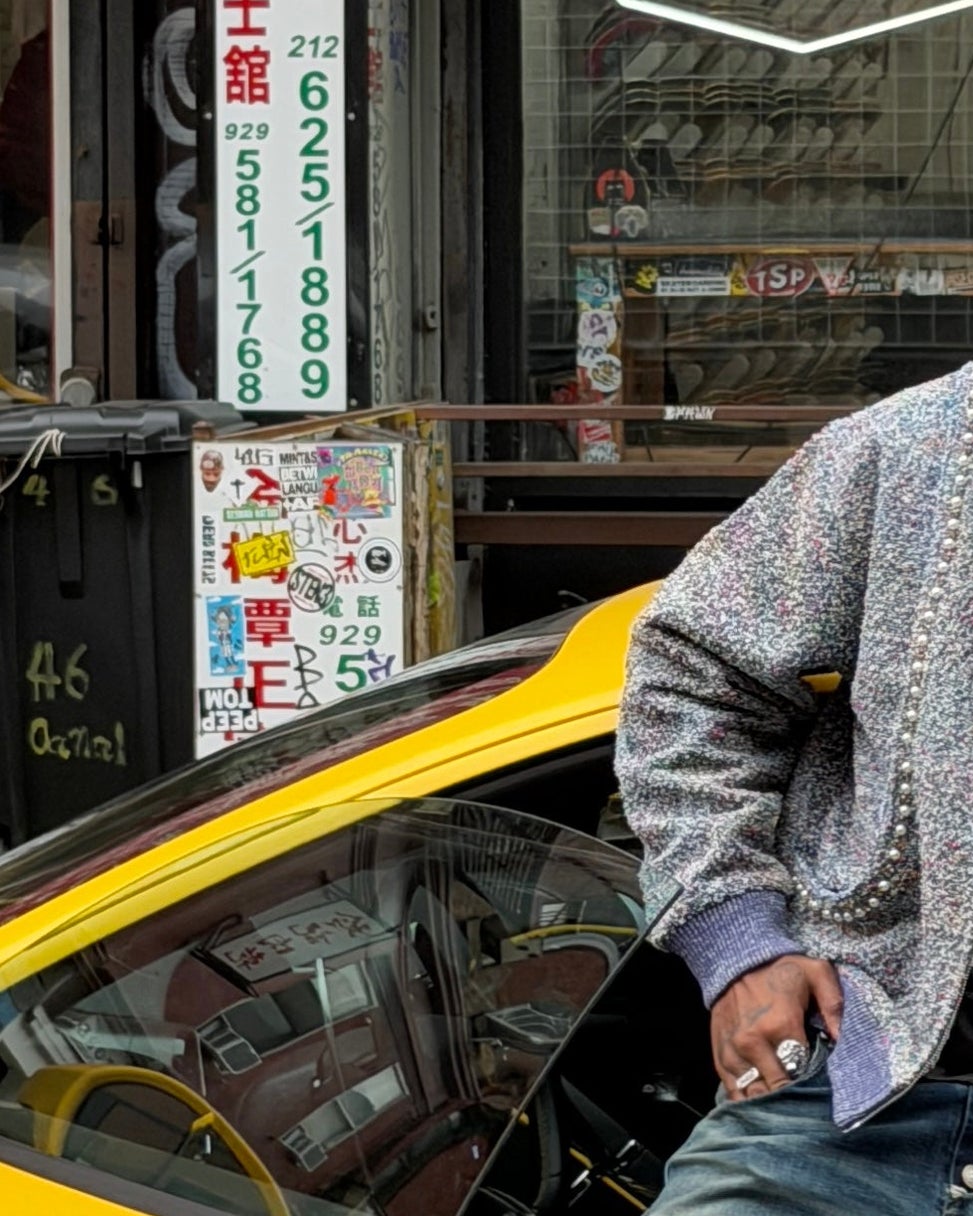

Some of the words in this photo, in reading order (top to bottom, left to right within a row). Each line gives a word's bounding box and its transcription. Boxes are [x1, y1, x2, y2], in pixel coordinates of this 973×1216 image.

[288, 35, 339, 58] 212
[224, 123, 269, 140] 929
[319, 624, 382, 646] 929
[204, 688, 254, 710] TOM
[202, 709, 258, 732] PEEP
